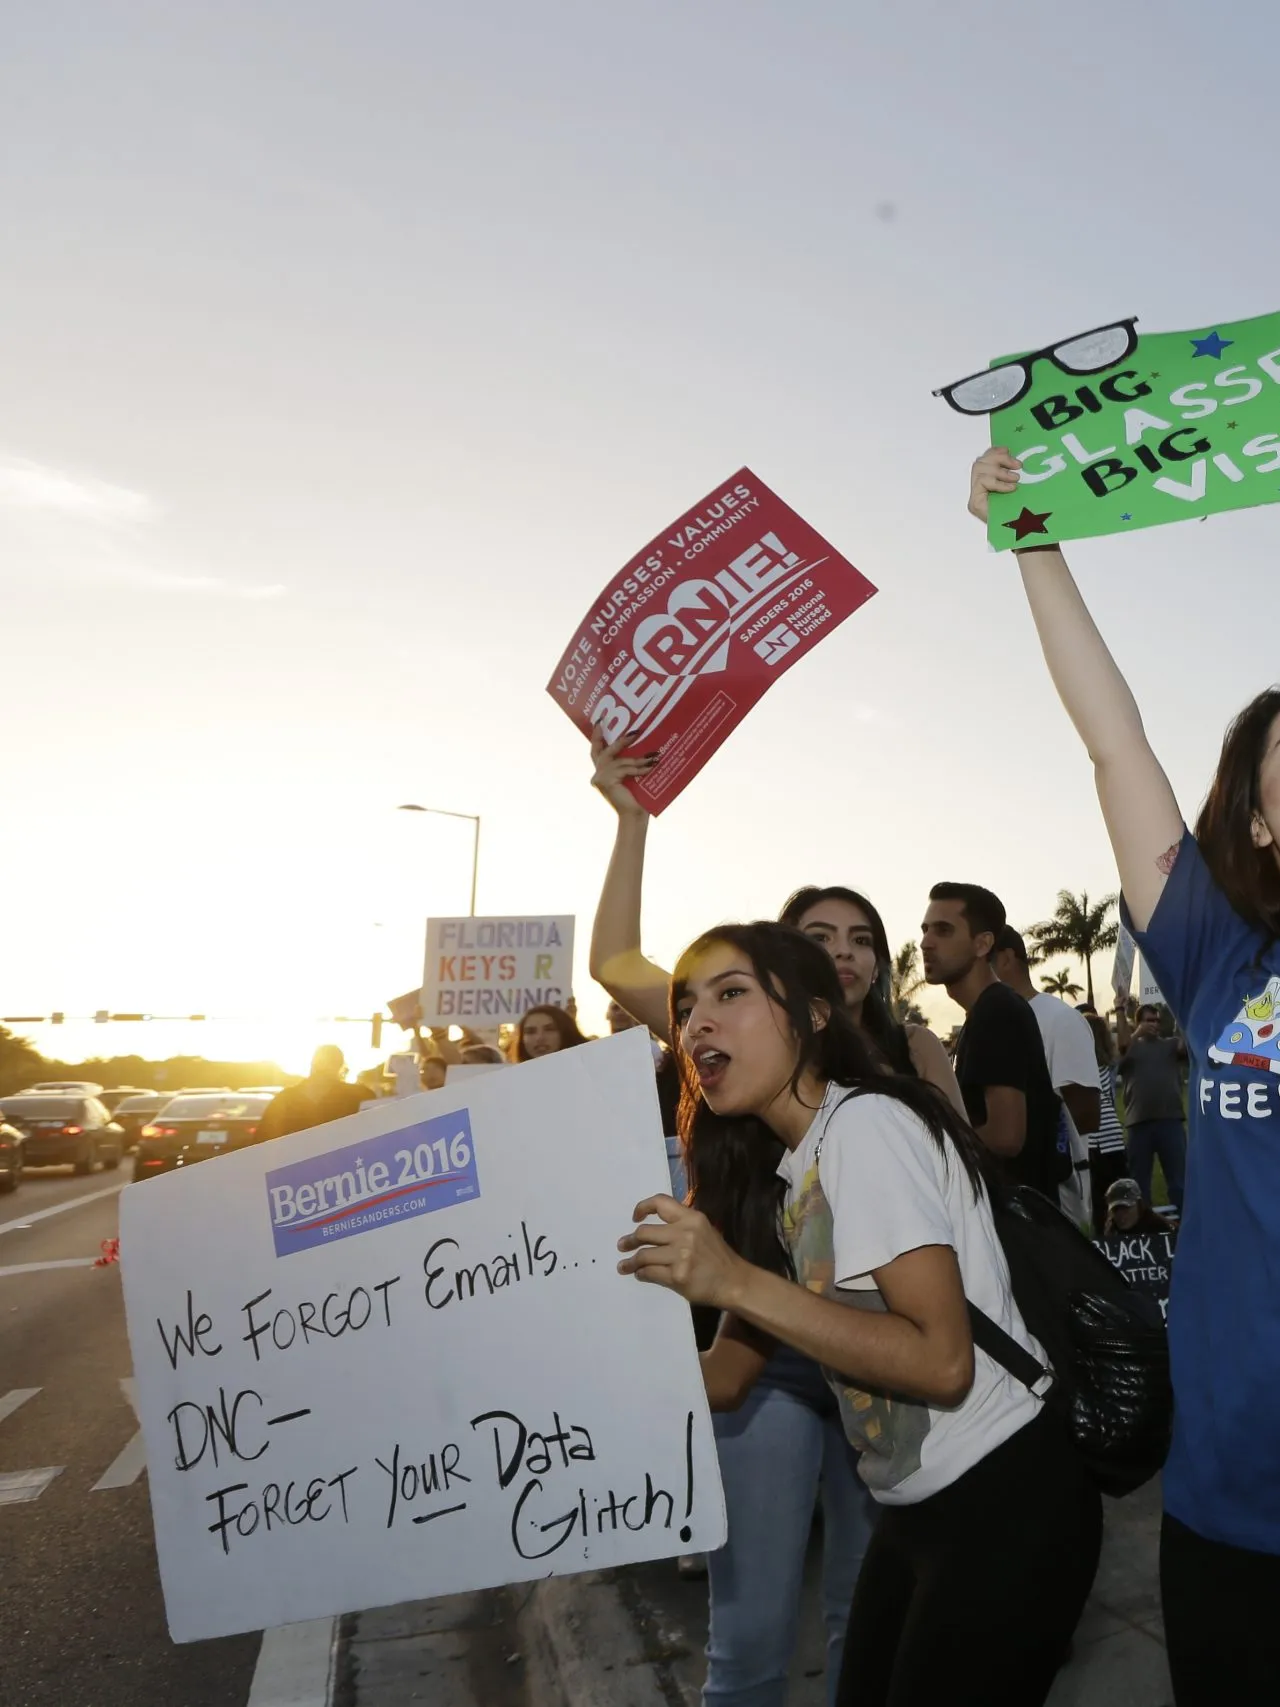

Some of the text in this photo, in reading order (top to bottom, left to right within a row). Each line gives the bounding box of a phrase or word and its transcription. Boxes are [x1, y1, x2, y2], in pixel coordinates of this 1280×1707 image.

[1030, 370, 1152, 431] BIG
[1081, 428, 1211, 498] BIG
[556, 484, 751, 694] VOTE NURSES' VALUES
[567, 497, 760, 706] CARING COMPASSION COMMUNITY
[740, 578, 814, 643] SANDERS 2016
[786, 590, 826, 624] National
[793, 603, 826, 631] Nurses
[590, 531, 800, 746] BERNIE!
[800, 609, 832, 636] United
[583, 650, 629, 716] NURSES FOR
[438, 921, 562, 949] FLORIDA
[439, 954, 553, 982] KEYS R
[436, 987, 563, 1016] BERNING
[270, 1131, 471, 1225] Bernie 2016
[322, 1197, 427, 1237] BERNIESANDERS.COM
[157, 1290, 223, 1370] We
[242, 1276, 401, 1360] FORGOT
[205, 1467, 358, 1555] FORGET
[471, 1410, 596, 1487] Data
